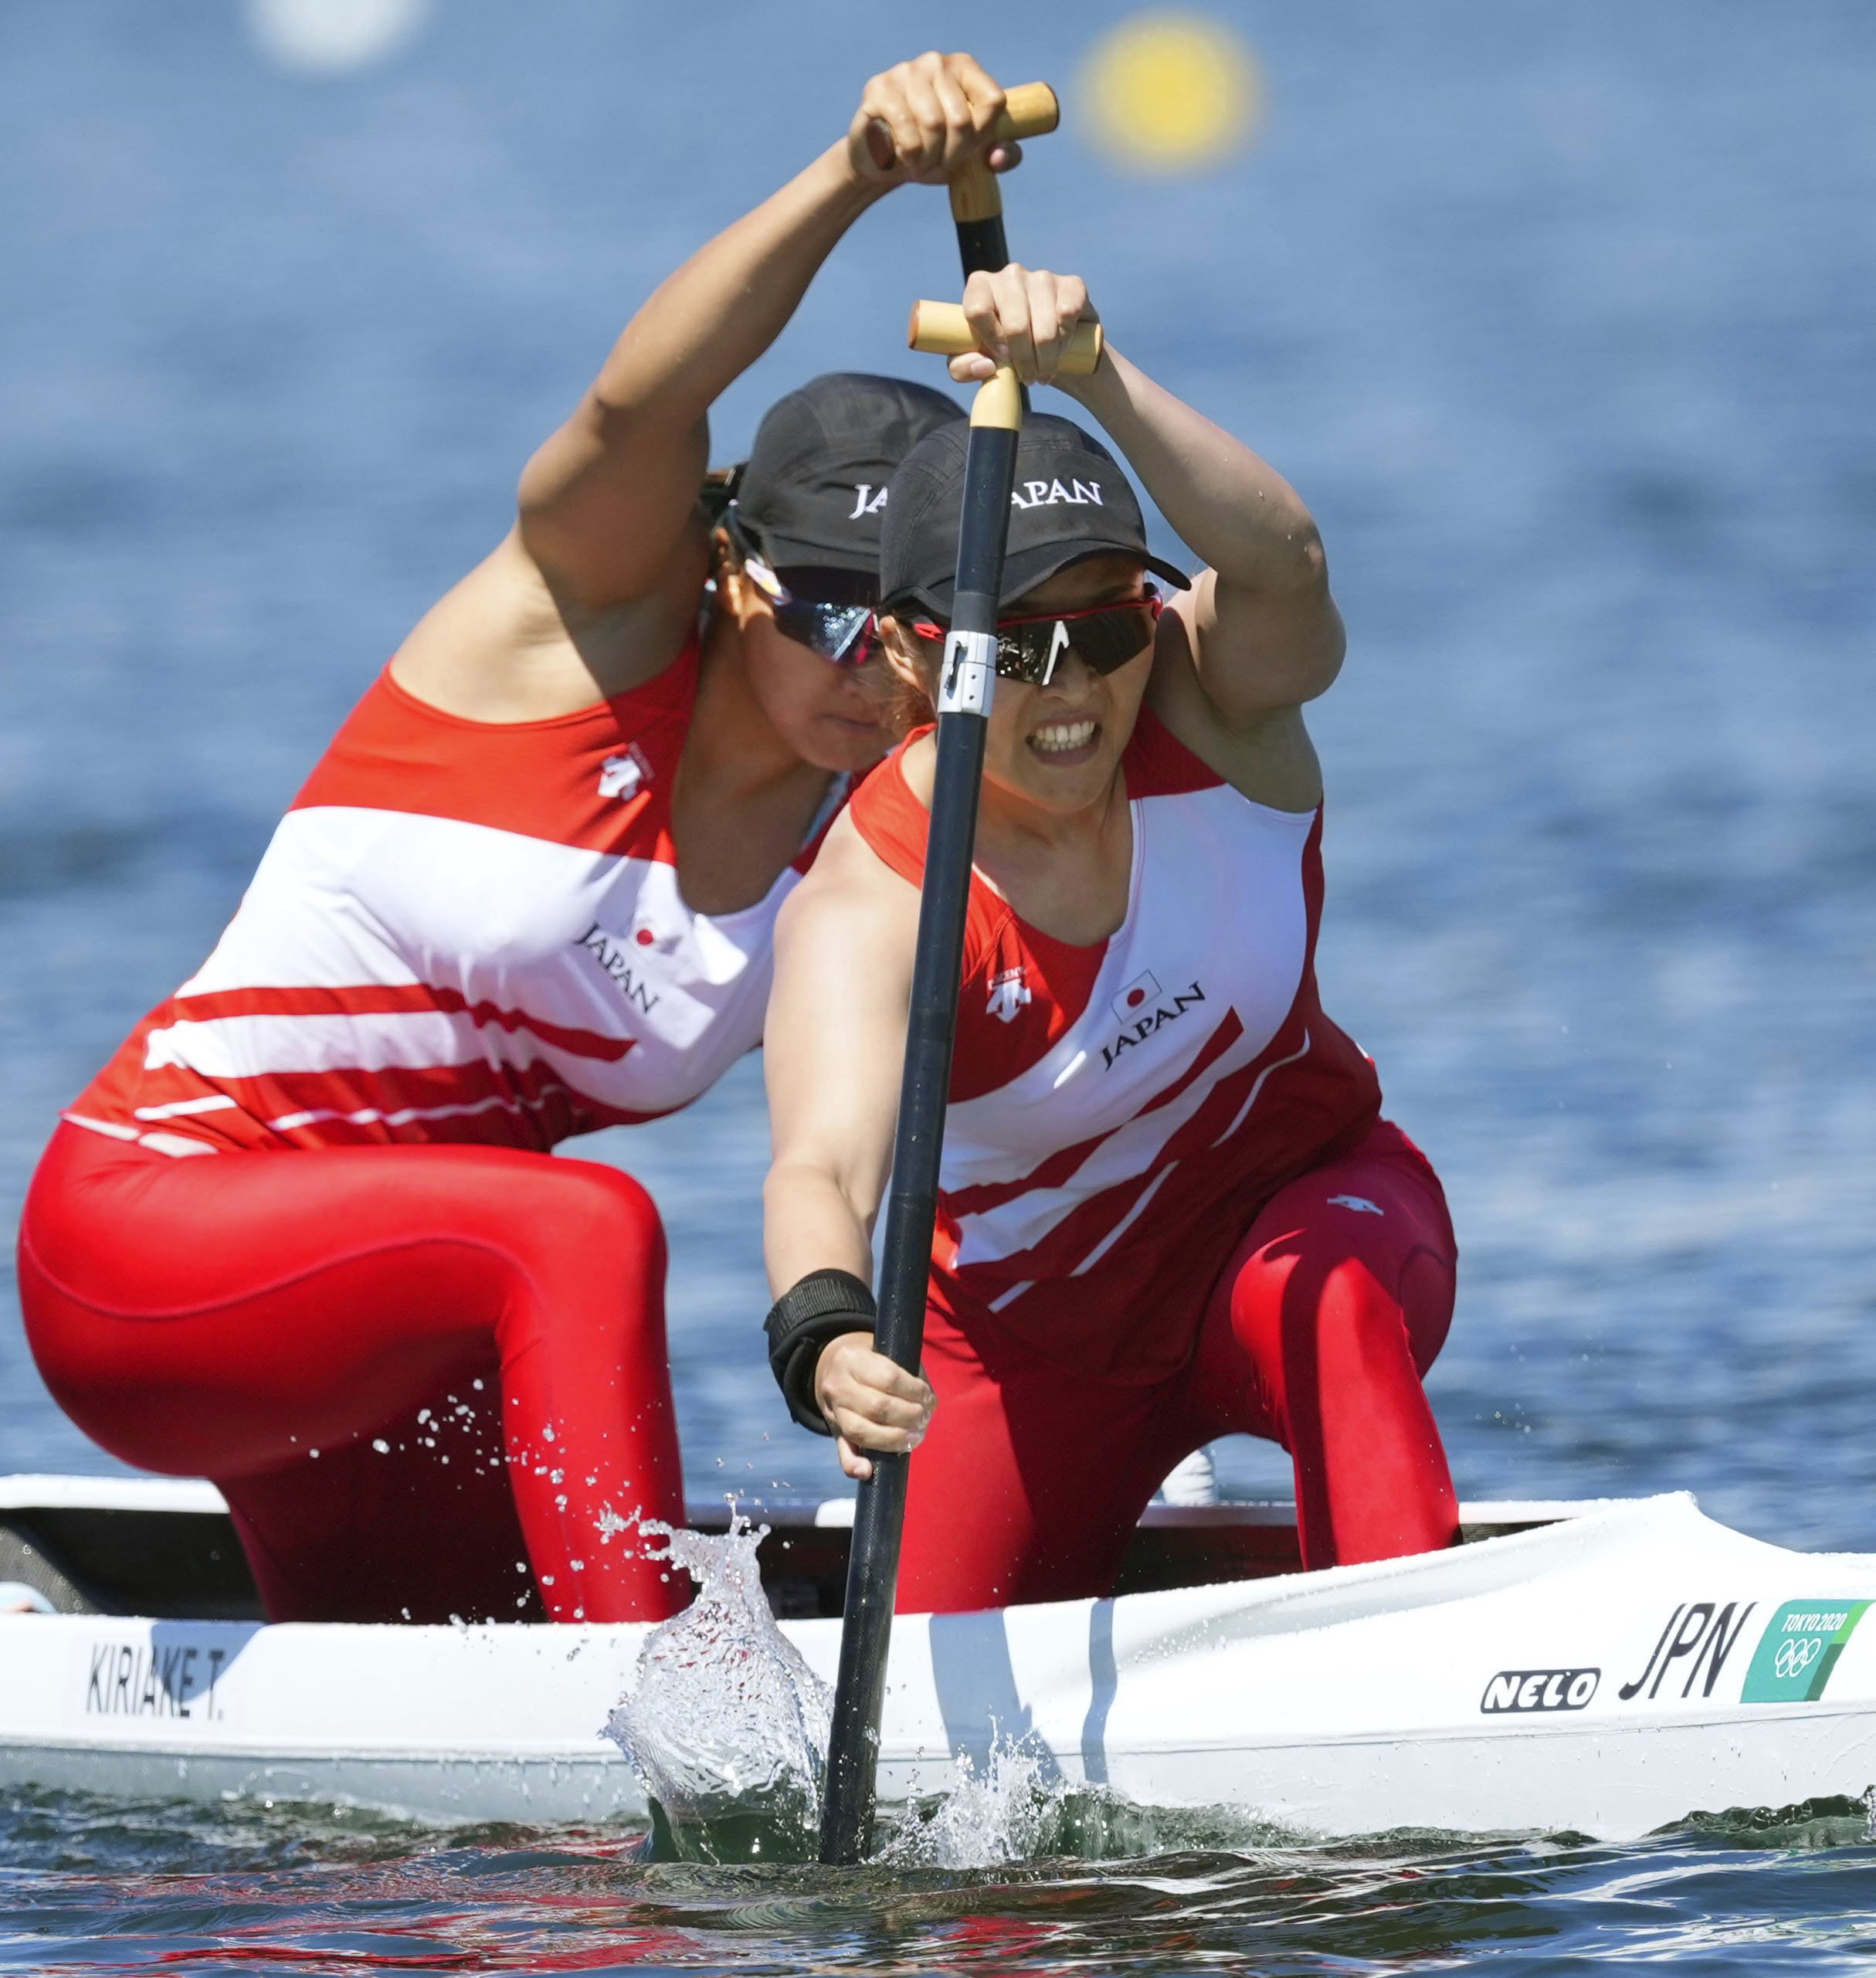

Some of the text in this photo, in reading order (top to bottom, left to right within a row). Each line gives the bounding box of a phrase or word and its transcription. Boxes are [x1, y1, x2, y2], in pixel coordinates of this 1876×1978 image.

[1011, 478, 1103, 509] APAN
[574, 921, 660, 1014] JAPAN
[1101, 980, 1206, 1072] JAPAN
[1618, 1601, 1759, 1701] JPN
[1781, 1612, 1847, 1632] TOKYO 2020
[86, 1644, 225, 1720] KIRIAKE T.
[1482, 1671, 1598, 1710] NELO
